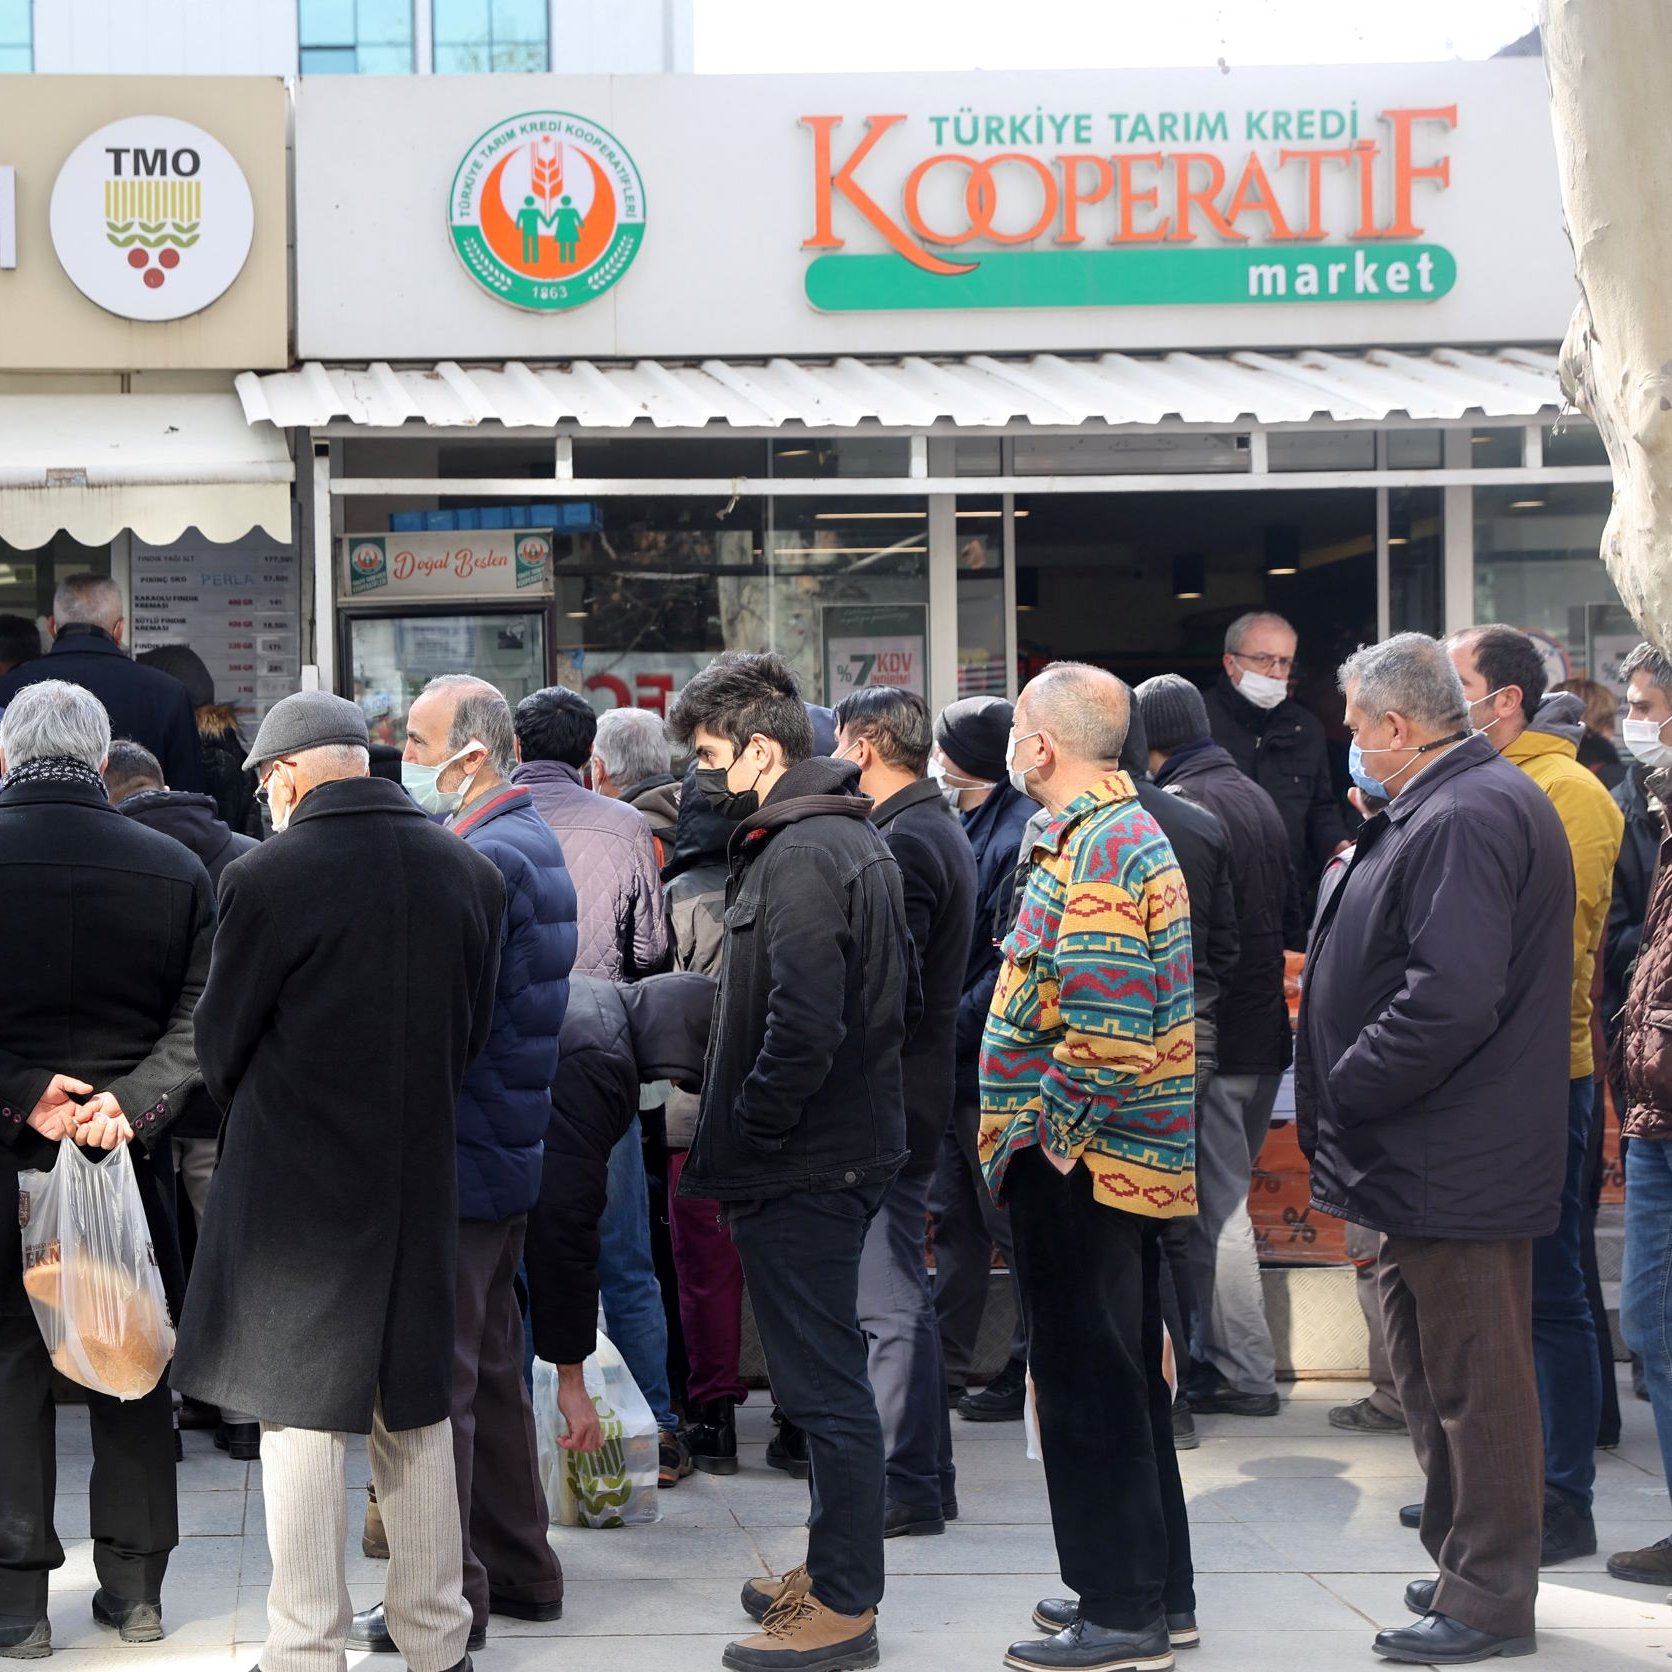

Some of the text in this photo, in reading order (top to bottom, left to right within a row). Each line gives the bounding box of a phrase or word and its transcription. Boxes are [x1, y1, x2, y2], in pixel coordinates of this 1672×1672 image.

[929, 100, 1360, 146] TÜRKİYE TARIM KREDİ
[105, 147, 201, 178] TMO
[460, 119, 638, 219] TÜRKİYE TARIM KREDİ KOOPERATİFLERİ
[799, 103, 1458, 276] KOOPERATİF
[1247, 249, 1436, 297] market
[531, 285, 569, 300] 1863
[201, 574, 255, 586] PERLA
[393, 551, 450, 580] Doğal
[454, 548, 509, 578] Beslen
[876, 652, 913, 673] KDV
